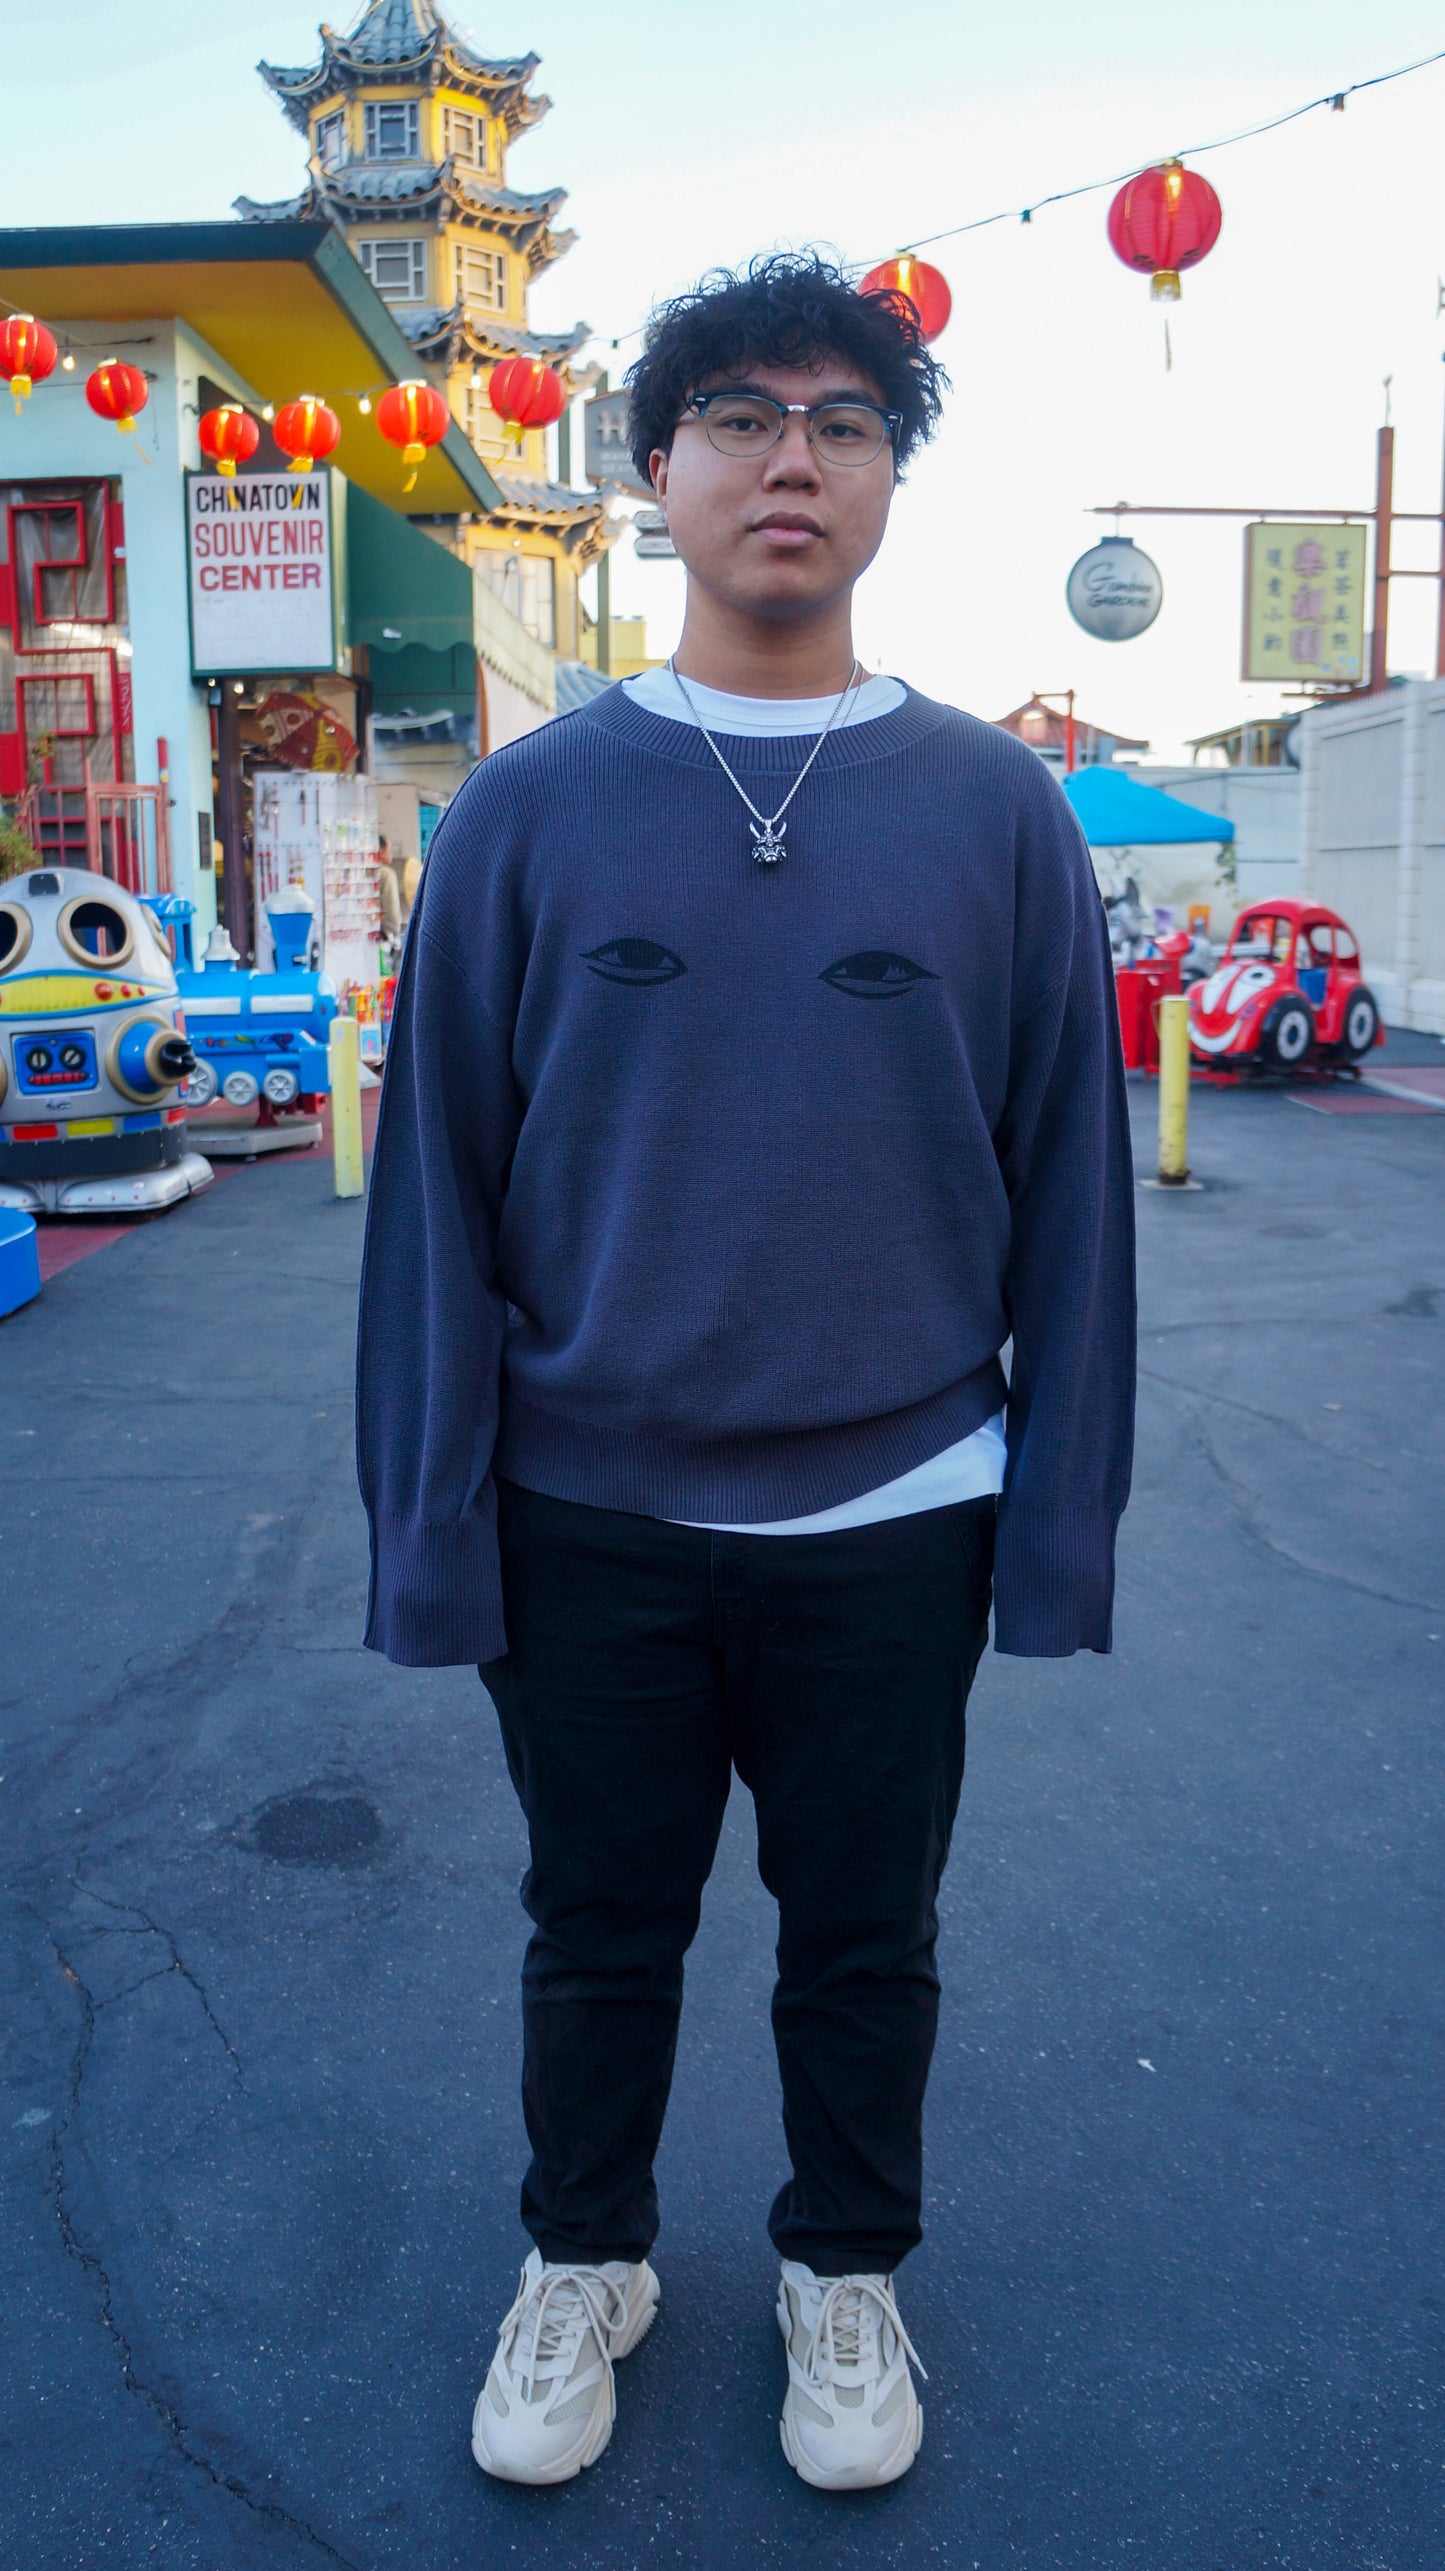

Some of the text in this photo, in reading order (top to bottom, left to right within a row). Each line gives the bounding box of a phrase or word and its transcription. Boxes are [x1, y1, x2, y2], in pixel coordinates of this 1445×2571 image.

[196, 483, 320, 513] CHINATOWN
[195, 519, 324, 559] SOUVENIR
[200, 562, 322, 592] CENTER
